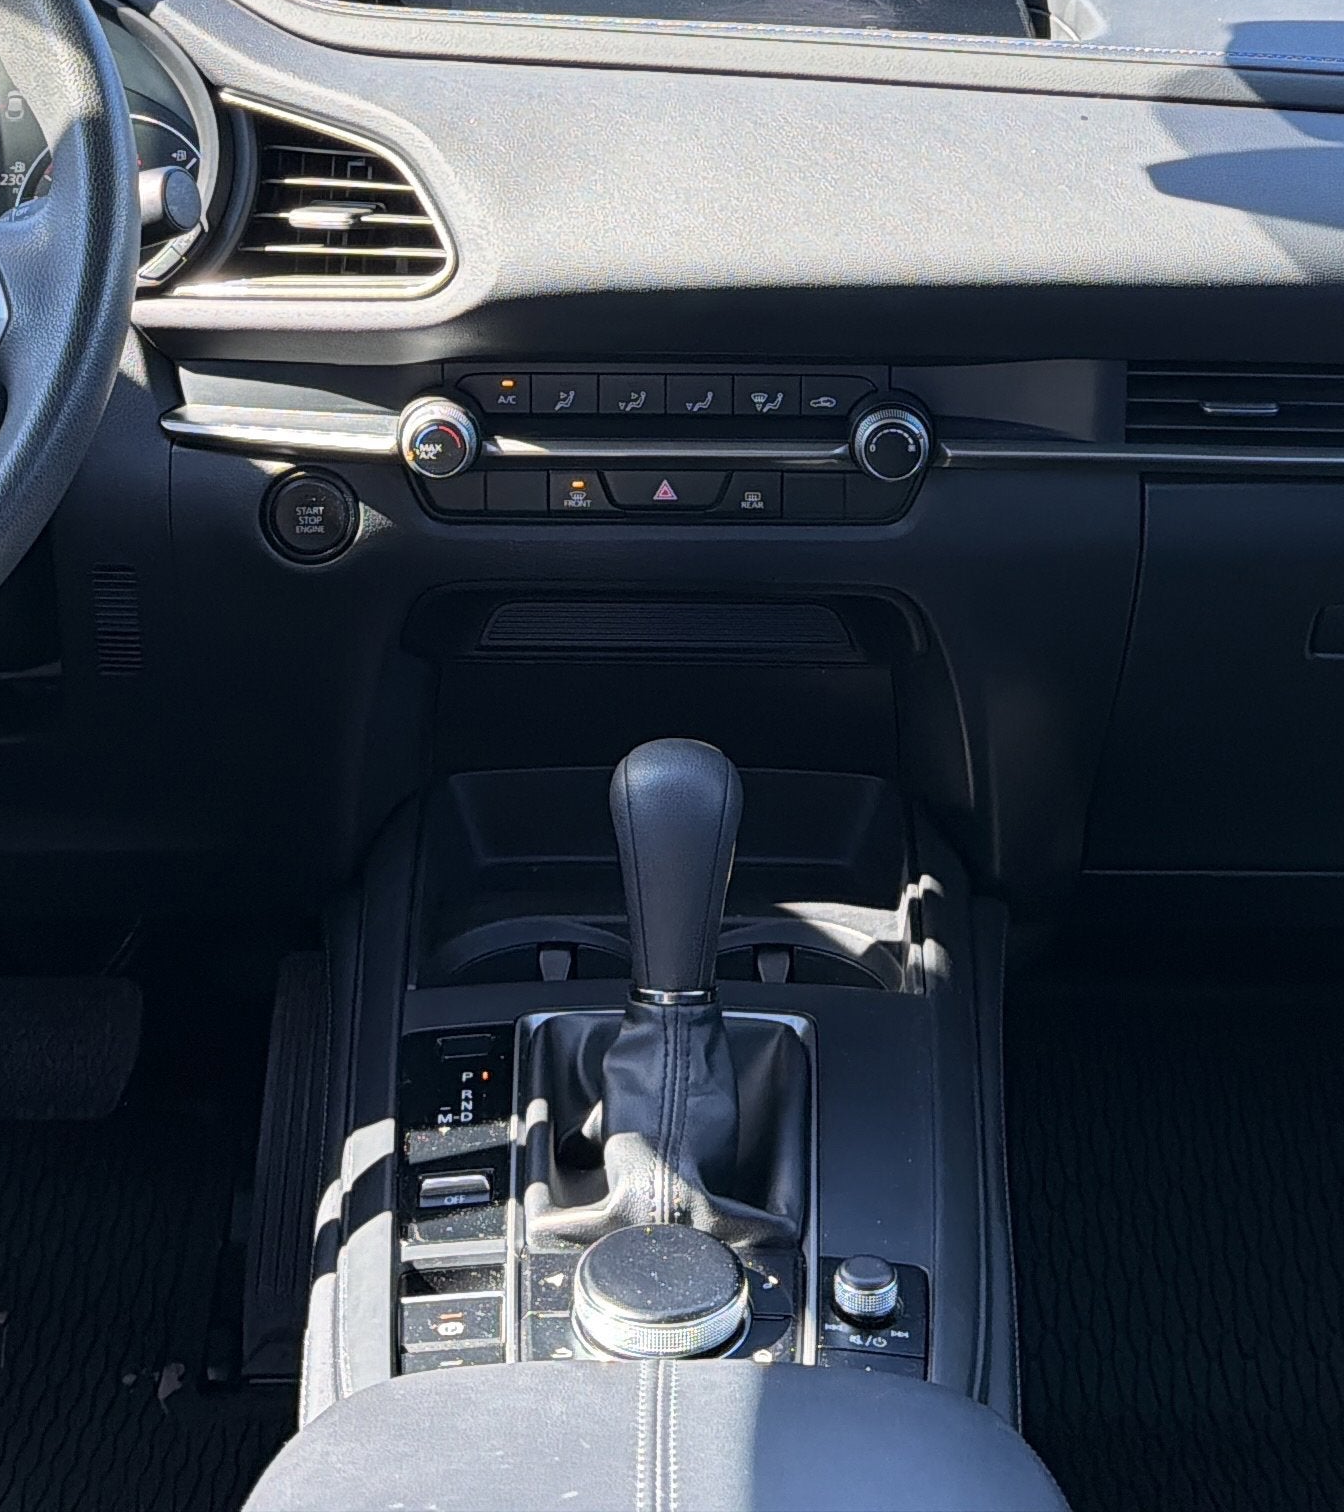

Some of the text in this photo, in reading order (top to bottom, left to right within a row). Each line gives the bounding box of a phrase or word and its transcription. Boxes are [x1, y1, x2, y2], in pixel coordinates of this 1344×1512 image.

[497, 394, 517, 405] A/C
[419, 443, 443, 452] MAX
[419, 451, 437, 460] A/C
[563, 499, 592, 508] FRONT
[741, 501, 764, 509] REAR
[296, 506, 325, 516] START
[298, 516, 323, 525] STOP
[296, 525, 326, 534] ENGINE
[461, 1071, 474, 1082] P
[461, 1089, 473, 1099] R
[460, 1100, 473, 1111] N
[443, 1195, 467, 1205] OFF
